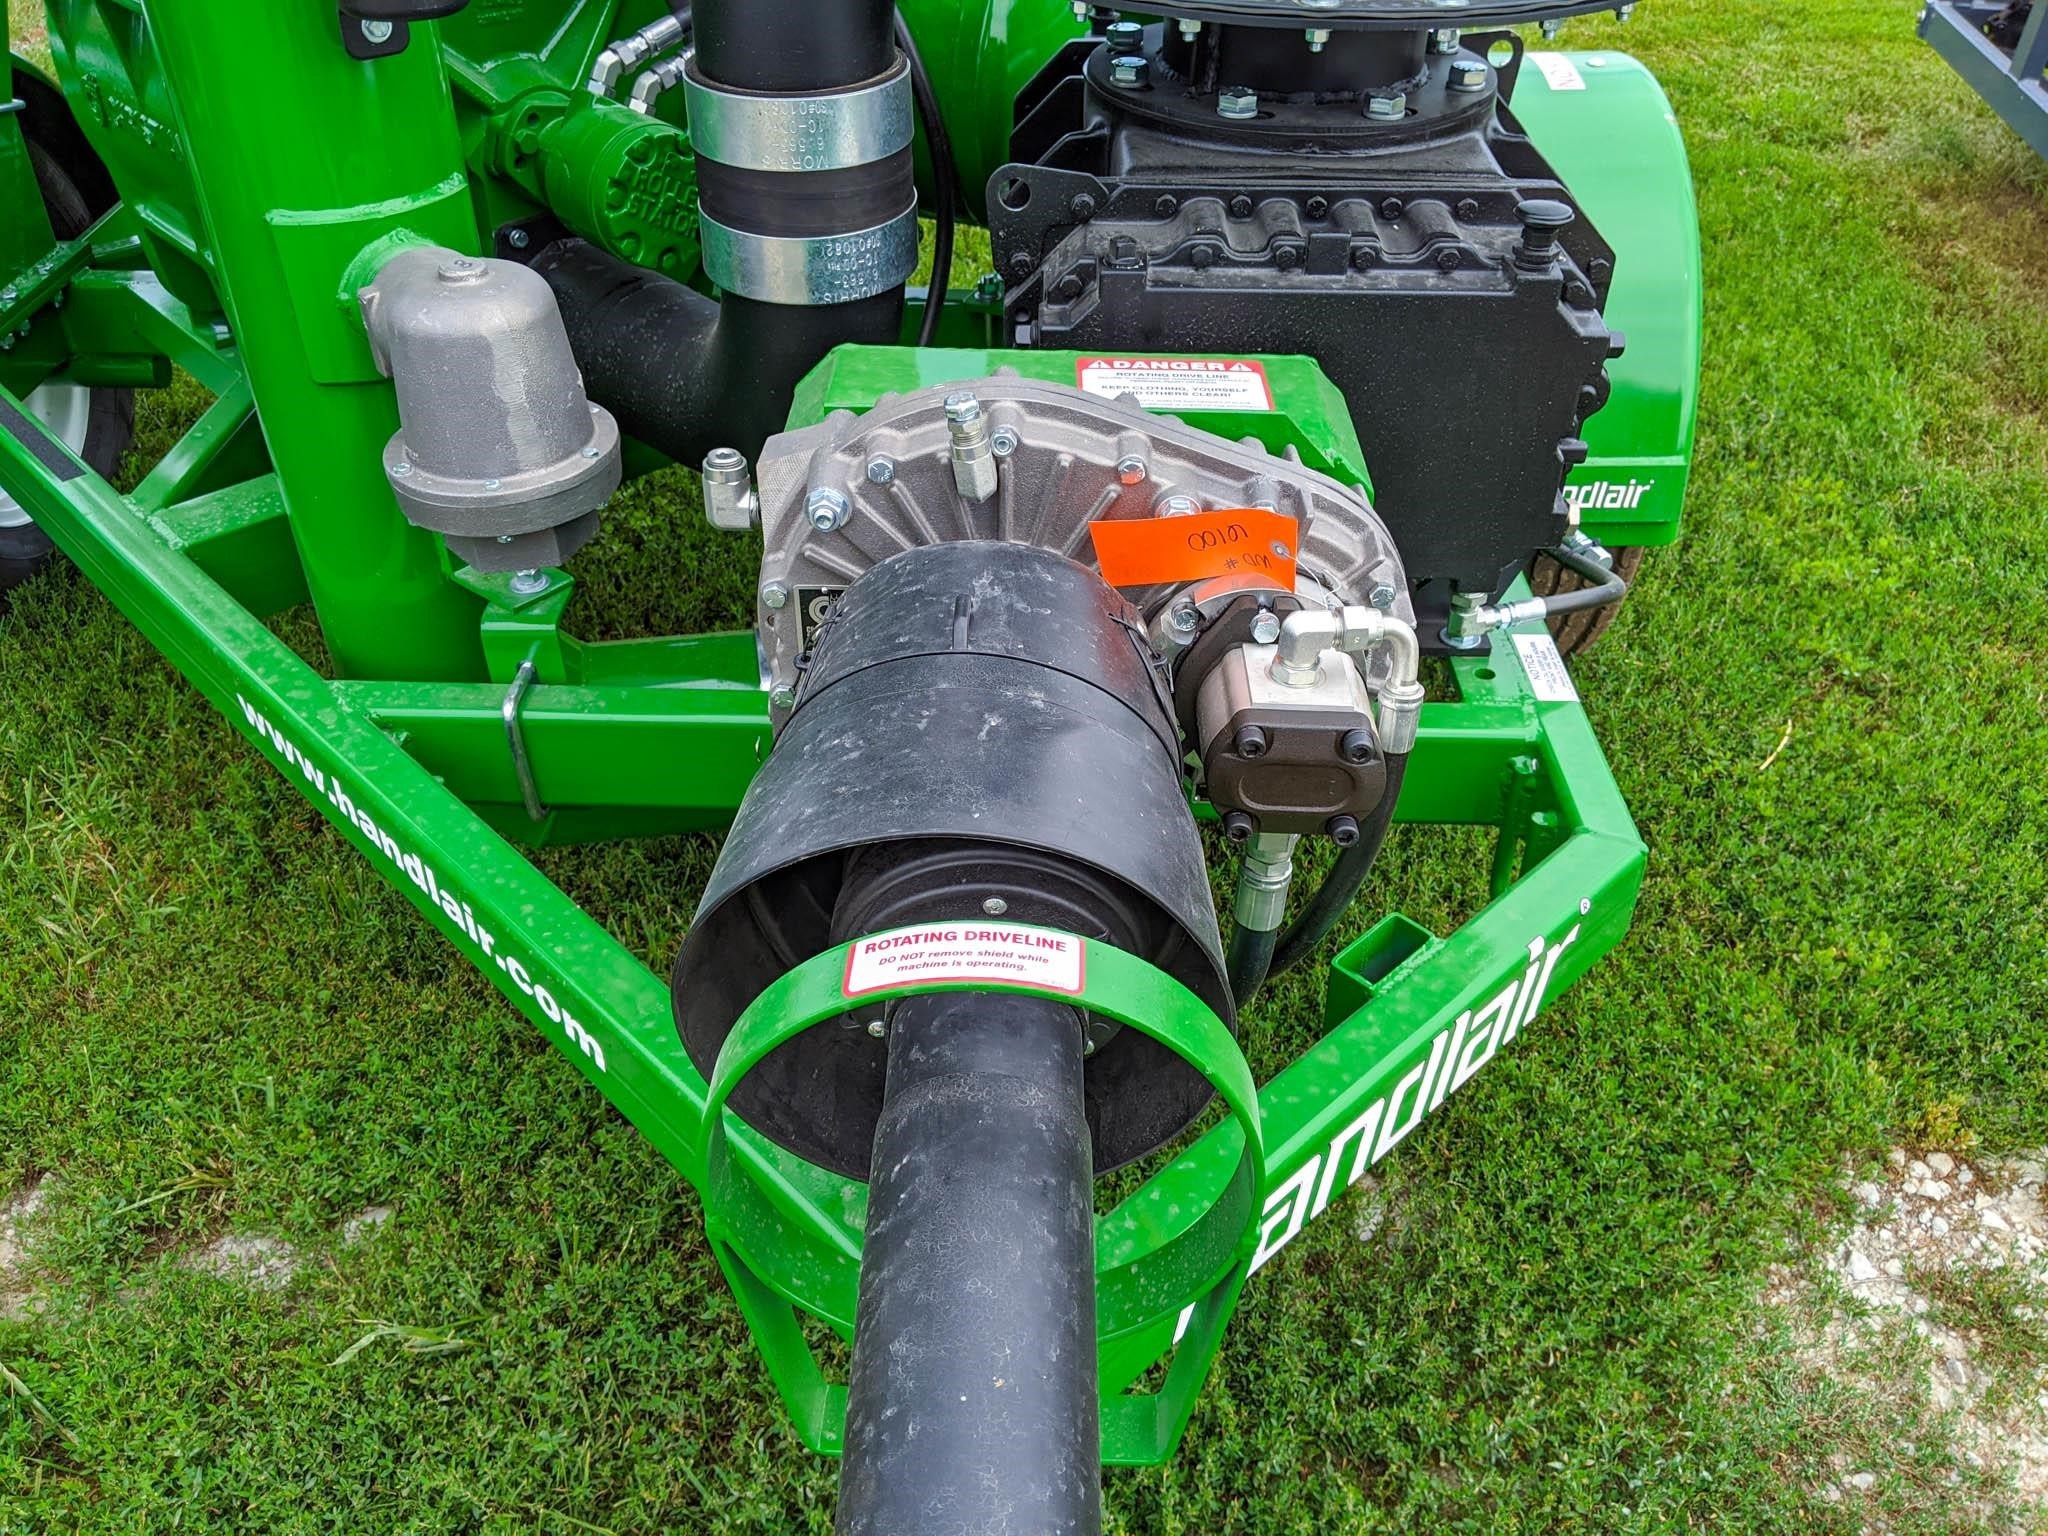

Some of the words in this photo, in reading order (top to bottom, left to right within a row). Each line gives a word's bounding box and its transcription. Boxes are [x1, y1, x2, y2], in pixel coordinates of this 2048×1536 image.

[1112, 360, 1226, 371] DANGER
[236, 693, 606, 1073] www.handlair.com
[864, 931, 958, 955] ROTATING
[963, 930, 1068, 953] DRIVELINE
[878, 955, 897, 967] DO
[899, 951, 926, 962] NOT
[927, 949, 973, 959] remove
[977, 949, 1014, 959] shield
[1017, 953, 1050, 965] while
[896, 959, 948, 972] machine
[951, 959, 962, 967] is
[966, 959, 1028, 972] operating.
[1173, 923, 1581, 1345] andlair
